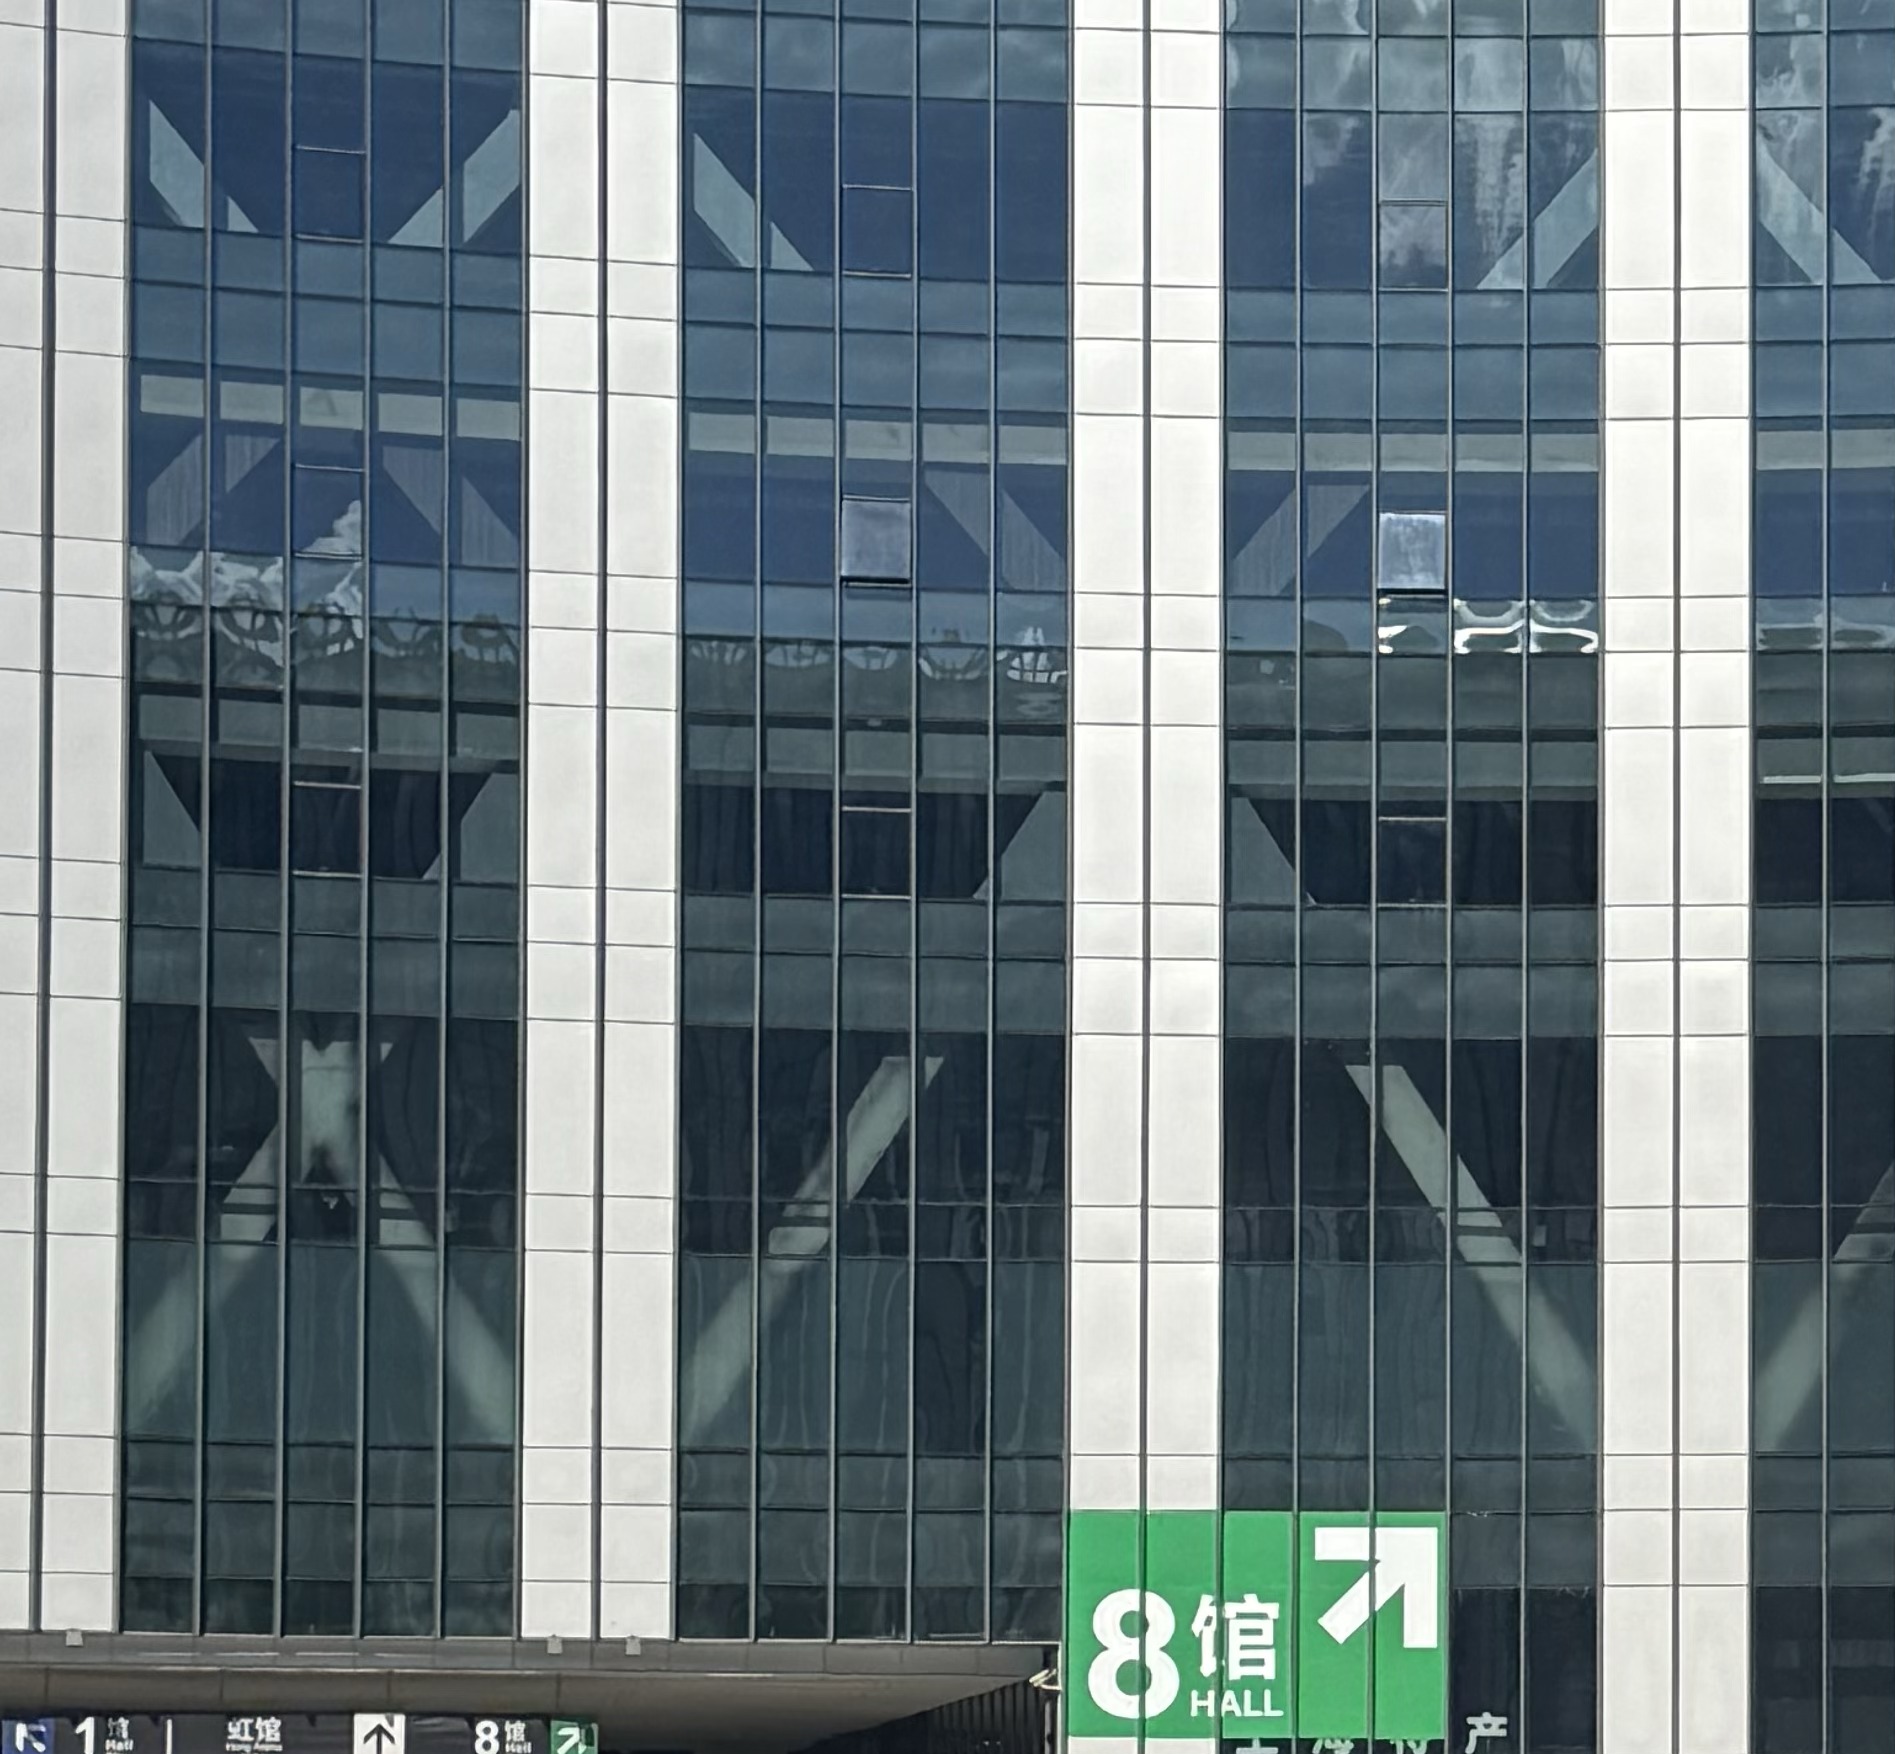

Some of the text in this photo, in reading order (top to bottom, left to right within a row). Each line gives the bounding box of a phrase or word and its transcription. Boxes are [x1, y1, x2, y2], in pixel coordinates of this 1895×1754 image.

[1087, 1588, 1280, 1719] 8 馆
[1190, 1688, 1285, 1718] HALL
[75, 1716, 95, 1754] 1
